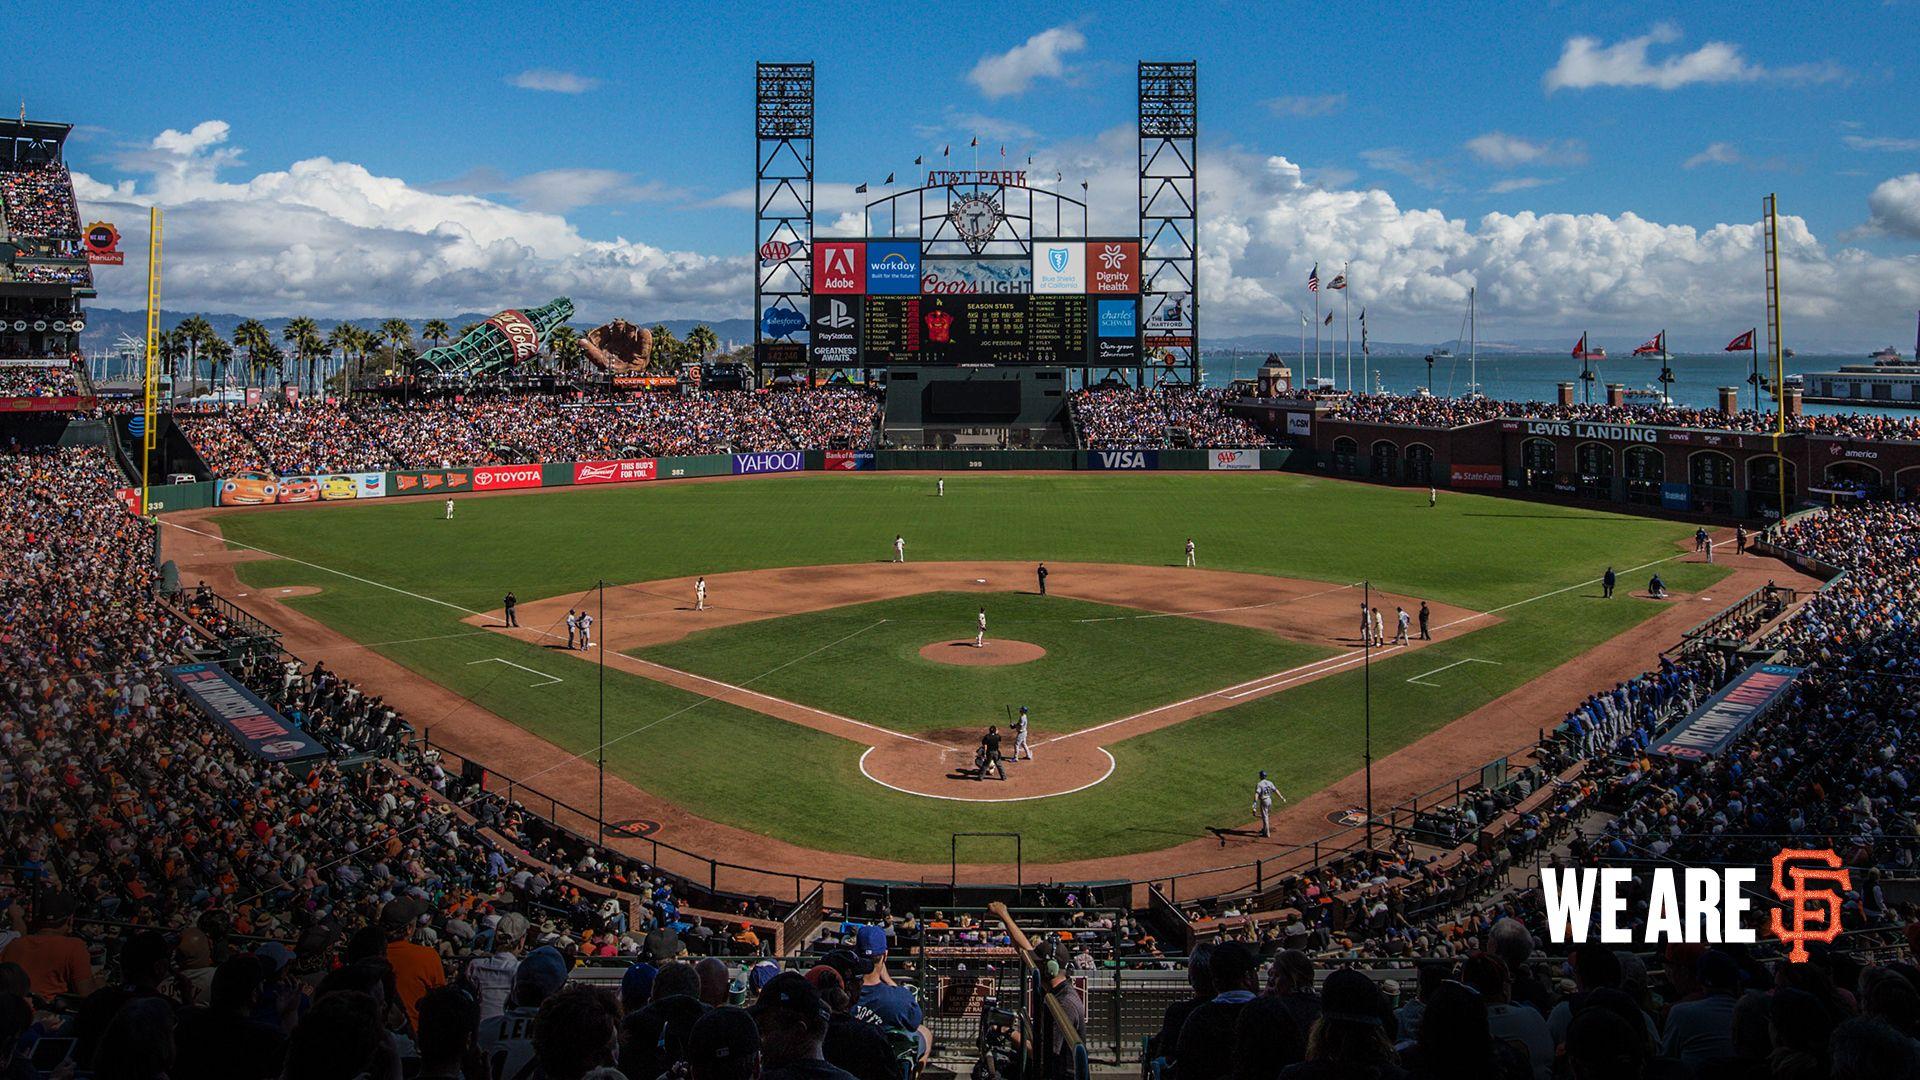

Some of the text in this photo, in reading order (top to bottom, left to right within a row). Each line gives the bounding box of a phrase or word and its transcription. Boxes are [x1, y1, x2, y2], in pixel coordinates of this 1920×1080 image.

[927, 171, 1026, 187] AT&T PARK
[761, 243, 790, 259] AAA
[1096, 272, 1129, 282] Dignity
[825, 278, 854, 288] Adobe
[921, 273, 1031, 294] Coors LIGHT
[1098, 282, 1128, 290] Health
[1102, 311, 1131, 320] charles
[767, 317, 801, 325] salesforce
[814, 347, 857, 355] GREATNESS
[1576, 425, 1657, 442] LANDING
[1218, 452, 1236, 463] AAA
[1844, 450, 1878, 459] america
[737, 452, 800, 473] YAHOO!
[1098, 452, 1146, 468] VISA
[620, 461, 653, 470] THIS BUD'S
[494, 471, 540, 482] TOYOTA
[632, 470, 647, 478] YOU.
[1463, 472, 1502, 481] State Farm
[148, 502, 164, 510] 339
[1764, 510, 1780, 518] 309
[1723, 687, 1774, 705] AT&T
[1711, 701, 1756, 713] TO
[1670, 708, 1750, 748] WELCOME
